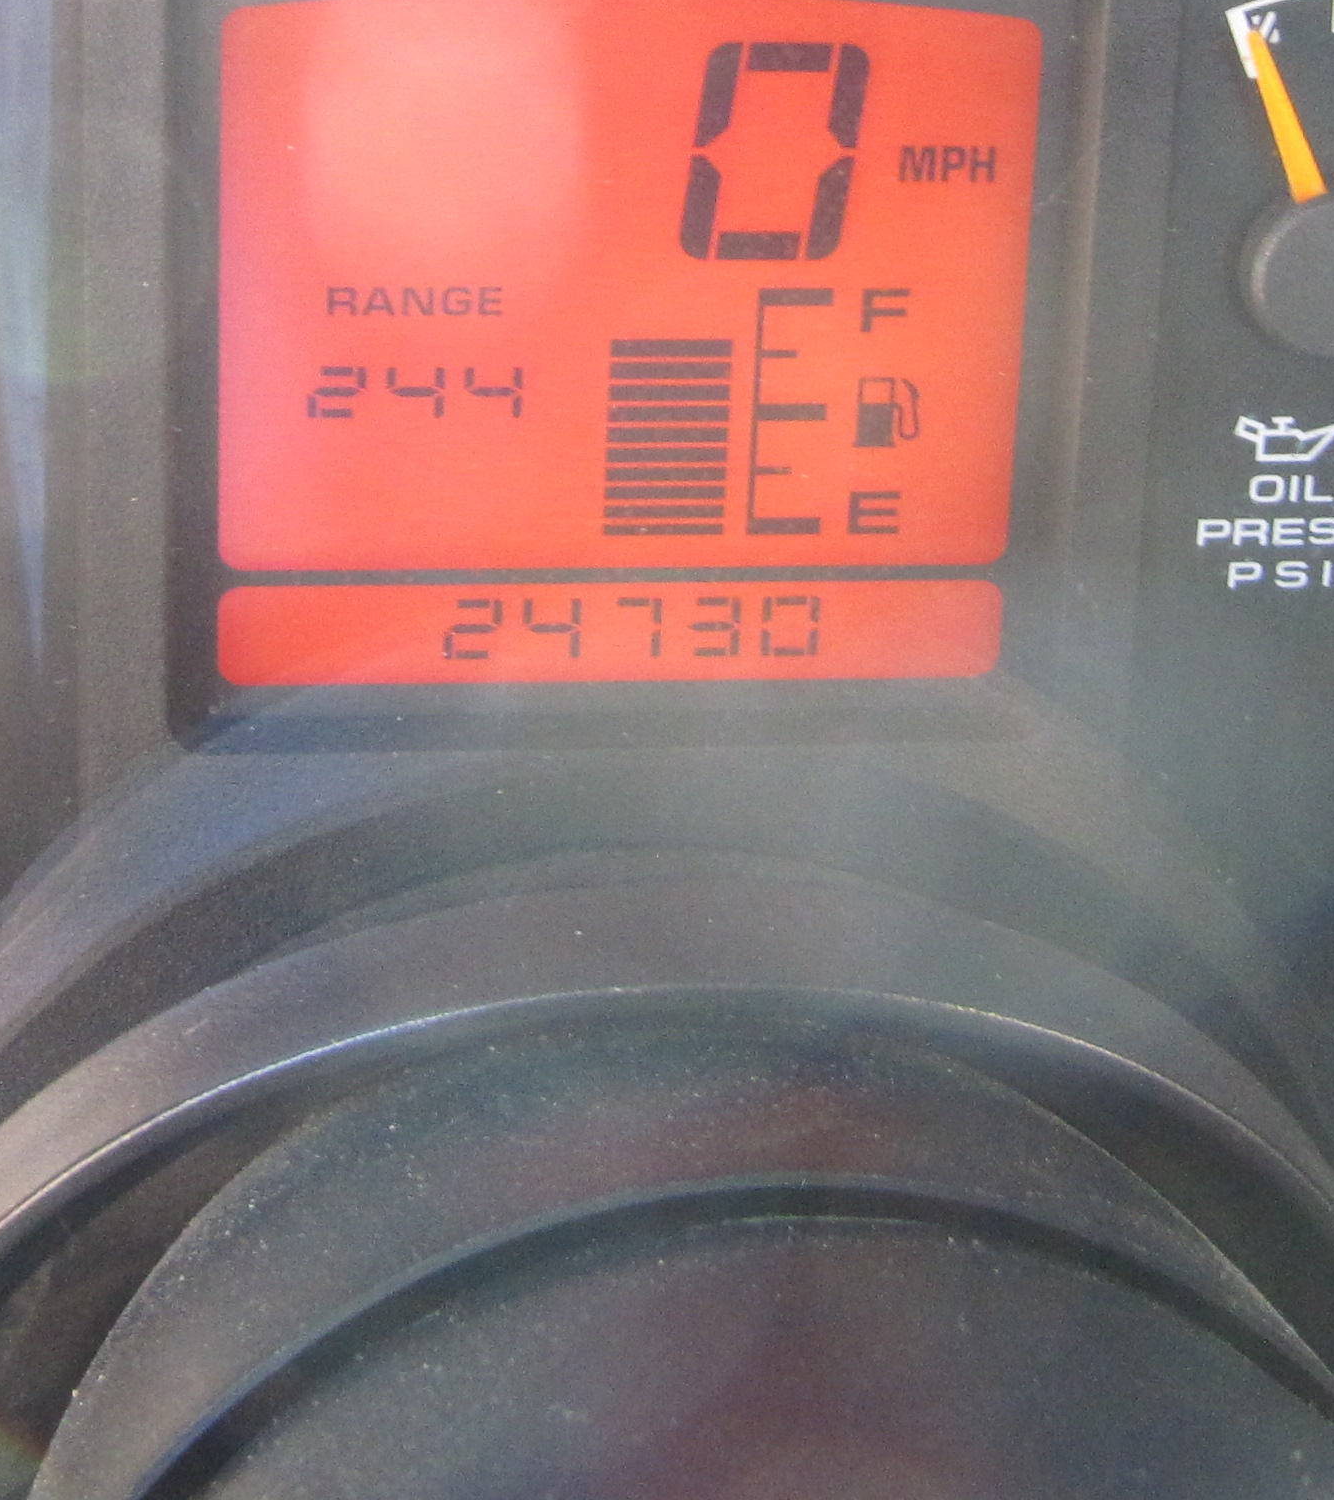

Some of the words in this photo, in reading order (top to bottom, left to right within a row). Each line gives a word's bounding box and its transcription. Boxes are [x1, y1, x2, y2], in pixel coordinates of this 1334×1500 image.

[680, 41, 870, 261] 0
[899, 145, 998, 183] MPH
[325, 286, 504, 317] RANGE
[861, 288, 911, 333] F
[306, 365, 524, 420] 244
[1248, 473, 1334, 504] OIL
[847, 491, 902, 535] E
[442, 596, 821, 662] 24730
